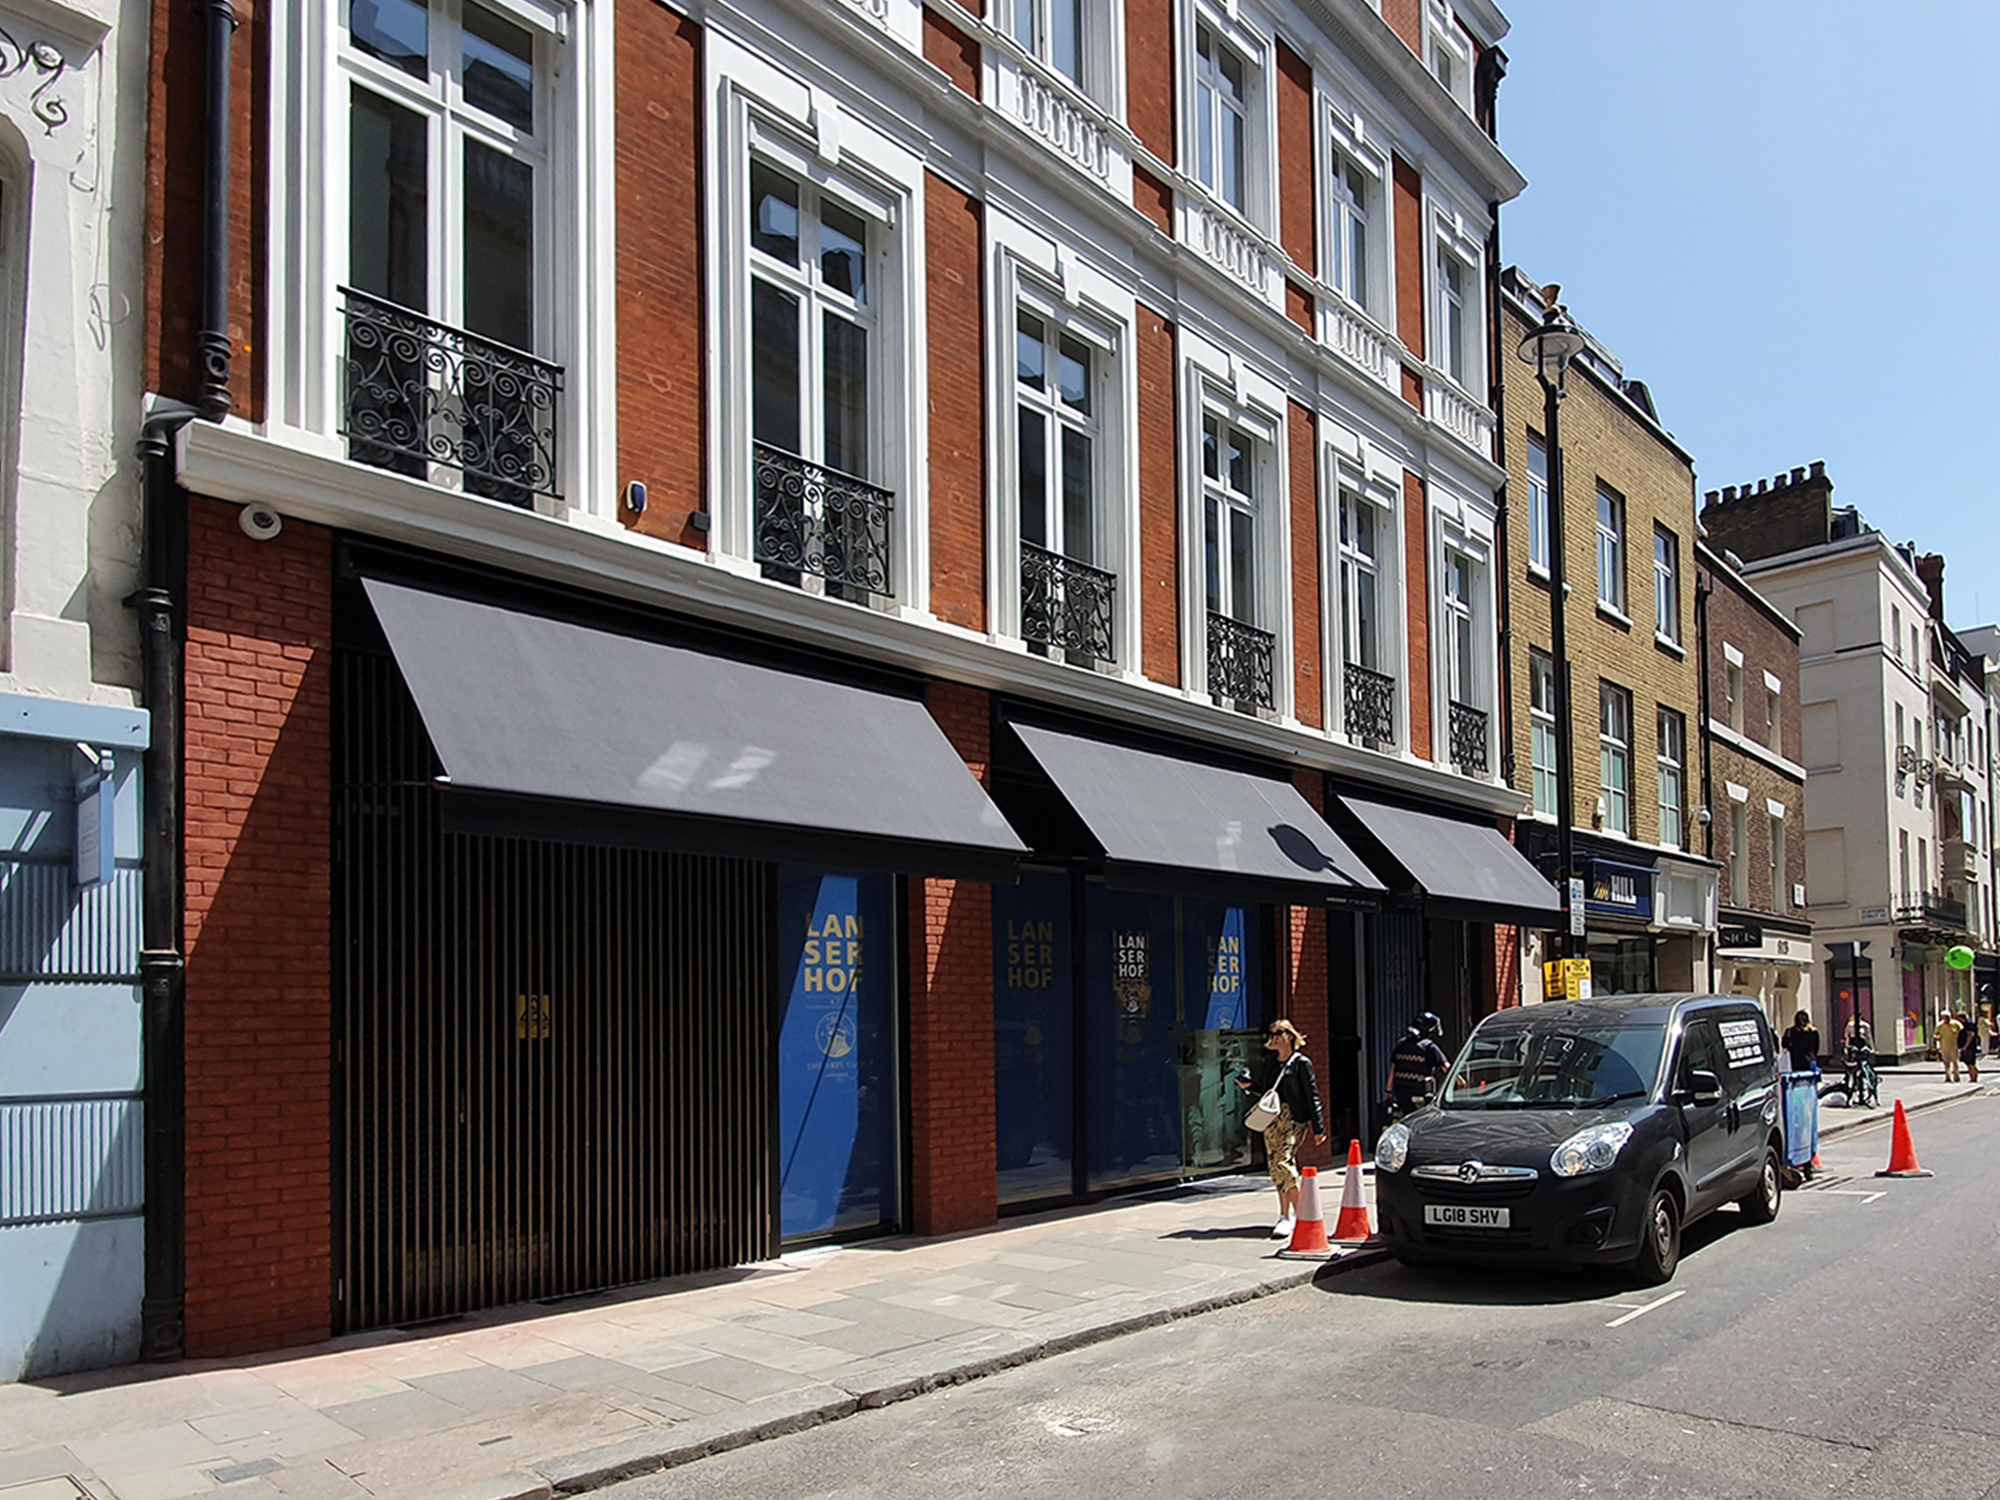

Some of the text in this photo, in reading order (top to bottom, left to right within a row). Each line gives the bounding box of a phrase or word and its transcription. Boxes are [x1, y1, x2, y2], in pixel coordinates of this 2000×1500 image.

[1611, 874, 1637, 905] HILL
[805, 912, 864, 939] LAN
[1007, 919, 1054, 942] LAN
[1118, 935, 1145, 949] LAN
[1207, 935, 1239, 954] LAN
[804, 940, 863, 966] SER
[1007, 943, 1053, 965] SER
[1118, 950, 1145, 963] SER
[1118, 964, 1145, 978] HOF
[1207, 955, 1239, 974] SER
[804, 967, 863, 993] HOF
[1007, 967, 1053, 989] HOF
[1206, 975, 1240, 993] HOF
[1433, 1207, 1500, 1224] LG18 SHV
